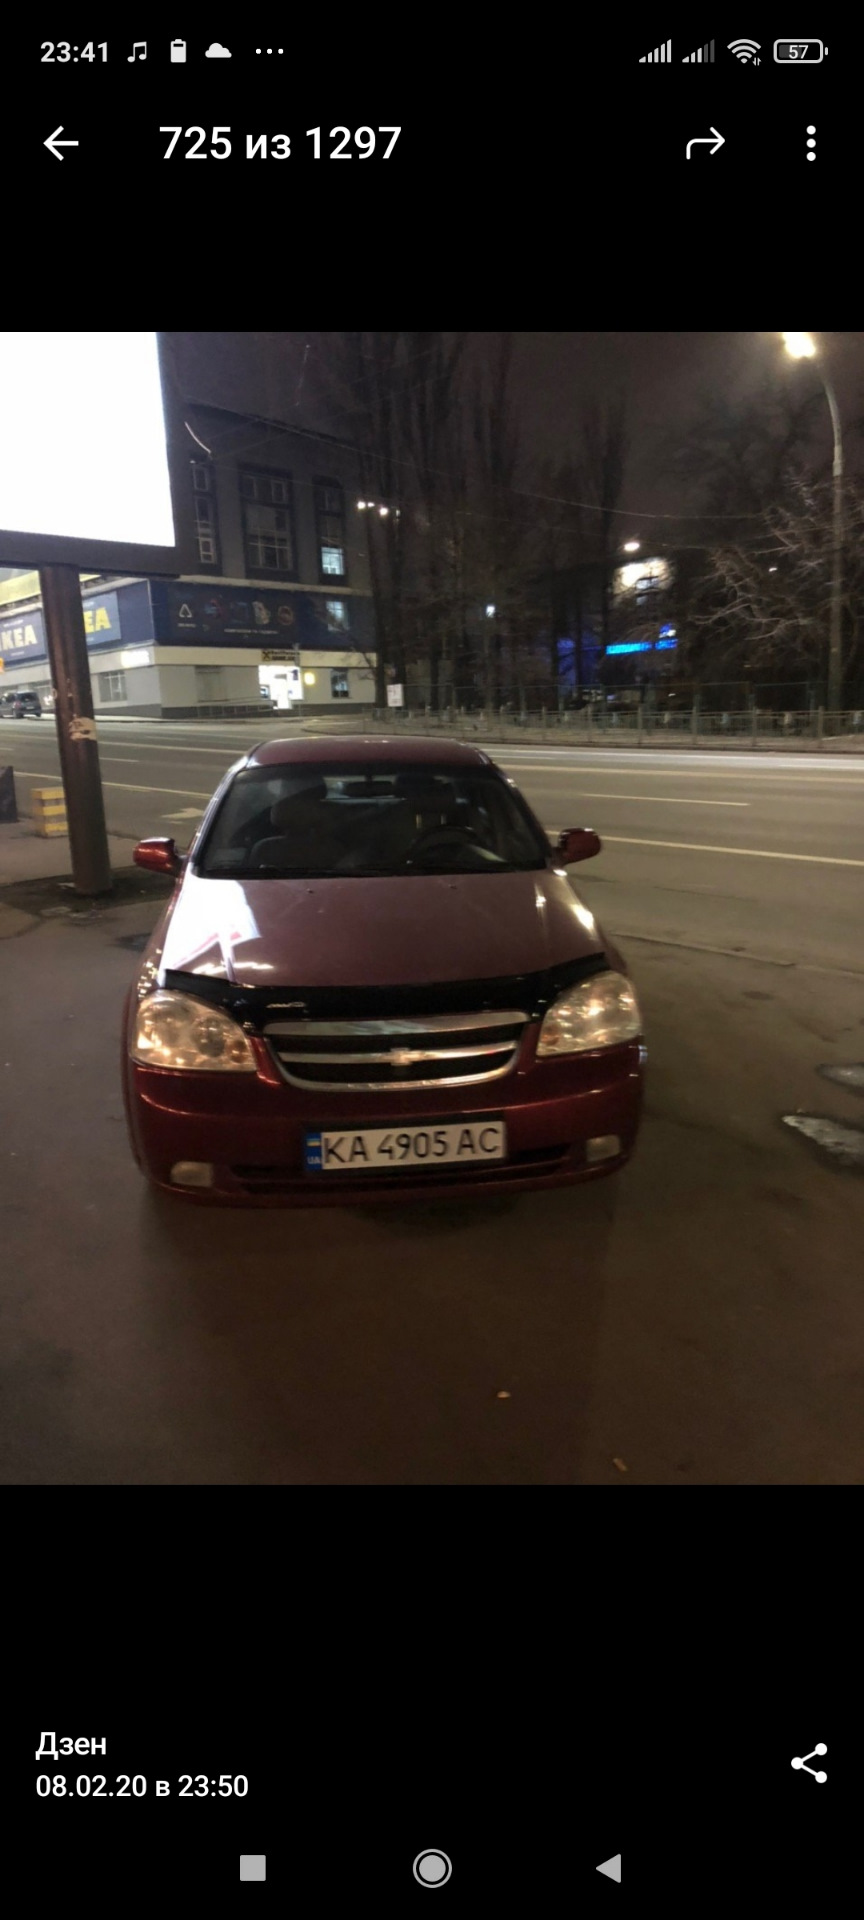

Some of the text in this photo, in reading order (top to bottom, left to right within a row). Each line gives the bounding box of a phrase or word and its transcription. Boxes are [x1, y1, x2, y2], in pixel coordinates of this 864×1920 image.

[83, 606, 112, 634] EA
[0, 624, 38, 652] KEA
[323, 1127, 500, 1164] KA 4905 AC
